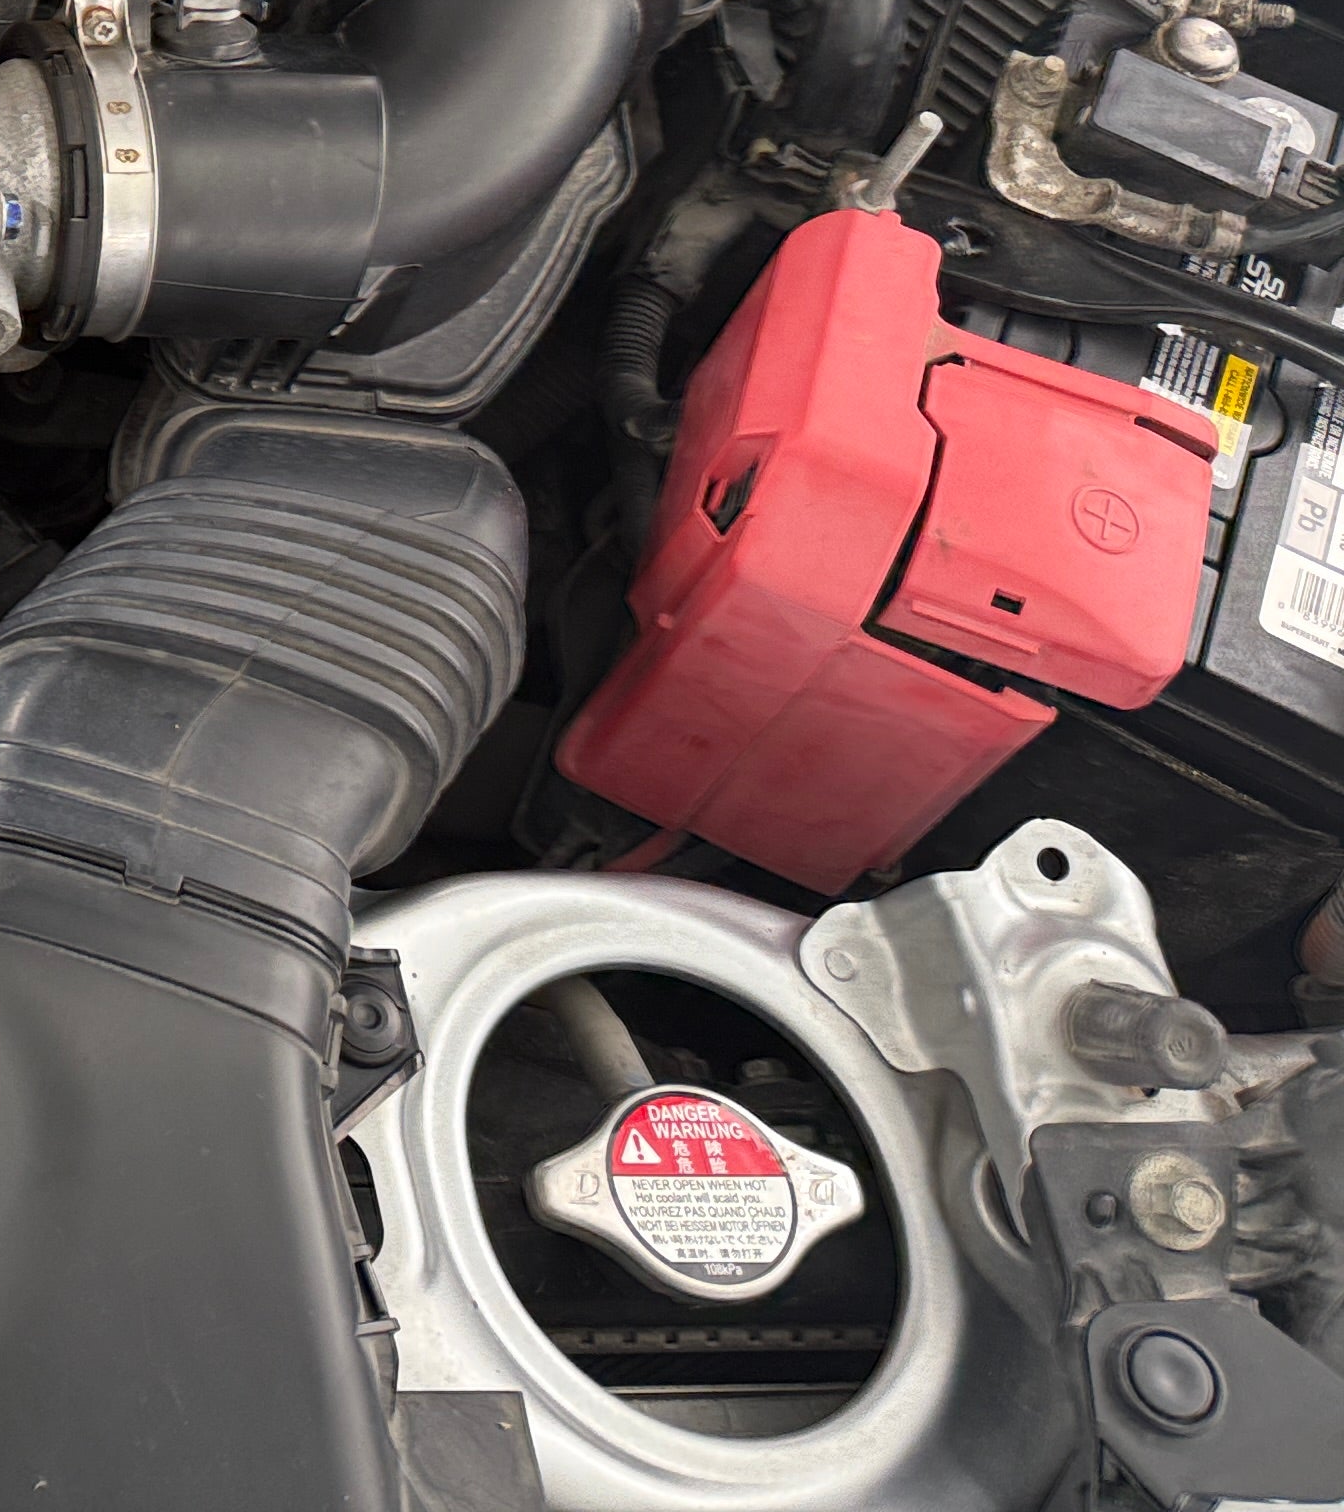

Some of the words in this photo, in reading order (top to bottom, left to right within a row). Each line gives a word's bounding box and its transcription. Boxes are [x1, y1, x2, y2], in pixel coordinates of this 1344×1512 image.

[1297, 497, 1328, 533] Pb
[647, 1105, 722, 1122] DANGER
[652, 1122, 743, 1139] WARNUNG
[632, 1179, 670, 1191] NEVER
[673, 1179, 706, 1191] OPEN
[707, 1179, 742, 1191] WHEN
[635, 1192, 653, 1203] Hot
[656, 1192, 692, 1203] coolant
[694, 1192, 711, 1204] will
[684, 1206, 706, 1218] PAS
[708, 1206, 746, 1218] QUAND
[637, 1220, 662, 1232] NICHT
[718, 1220, 750, 1232] MOTOR
